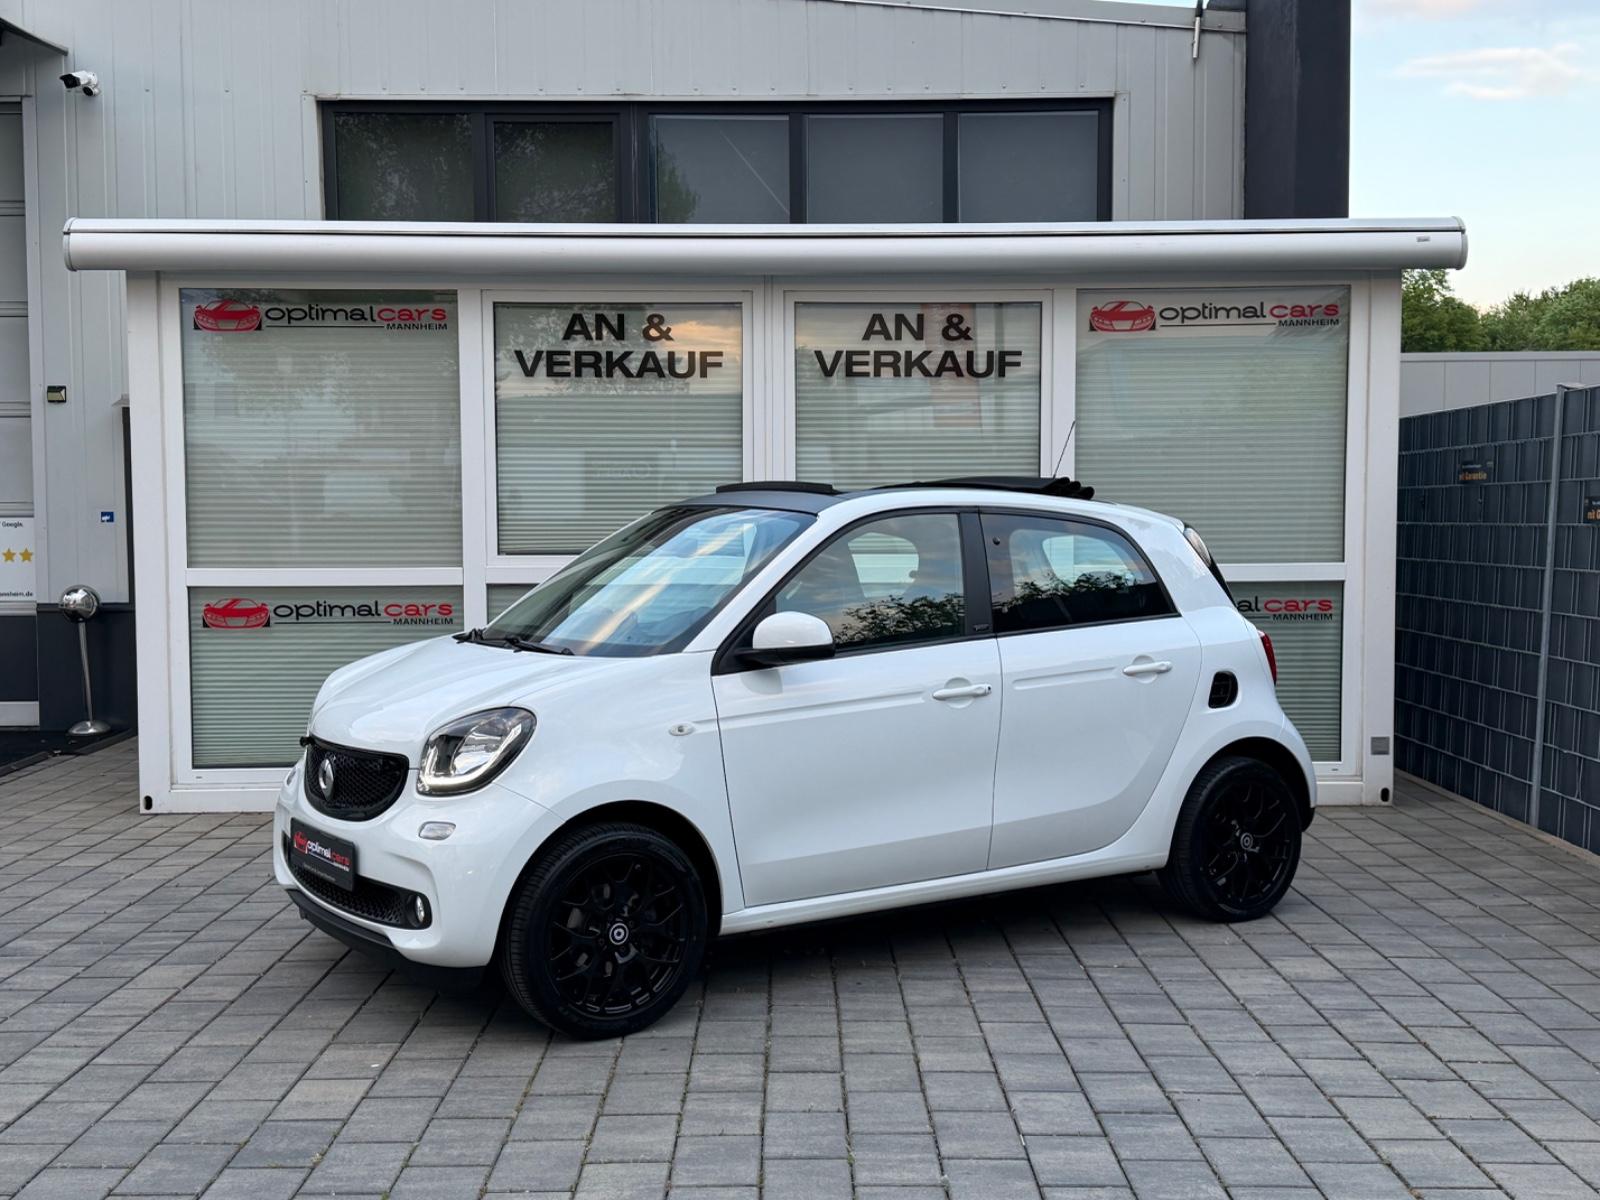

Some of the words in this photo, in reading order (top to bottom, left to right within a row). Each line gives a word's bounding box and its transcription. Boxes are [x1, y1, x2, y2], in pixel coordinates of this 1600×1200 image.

[385, 322, 448, 331] MANNHEIM
[562, 313, 625, 341] AN
[642, 313, 675, 342] &
[861, 313, 924, 341] AN
[941, 313, 973, 342] &
[1278, 318, 1340, 327] MANNHEIM
[514, 350, 724, 379] VERKAUF
[814, 350, 1023, 379] VERKAUF
[1263, 598, 1333, 613] cars
[393, 617, 454, 626] MANNHEIM
[1272, 613, 1333, 621] MANNHEIM
